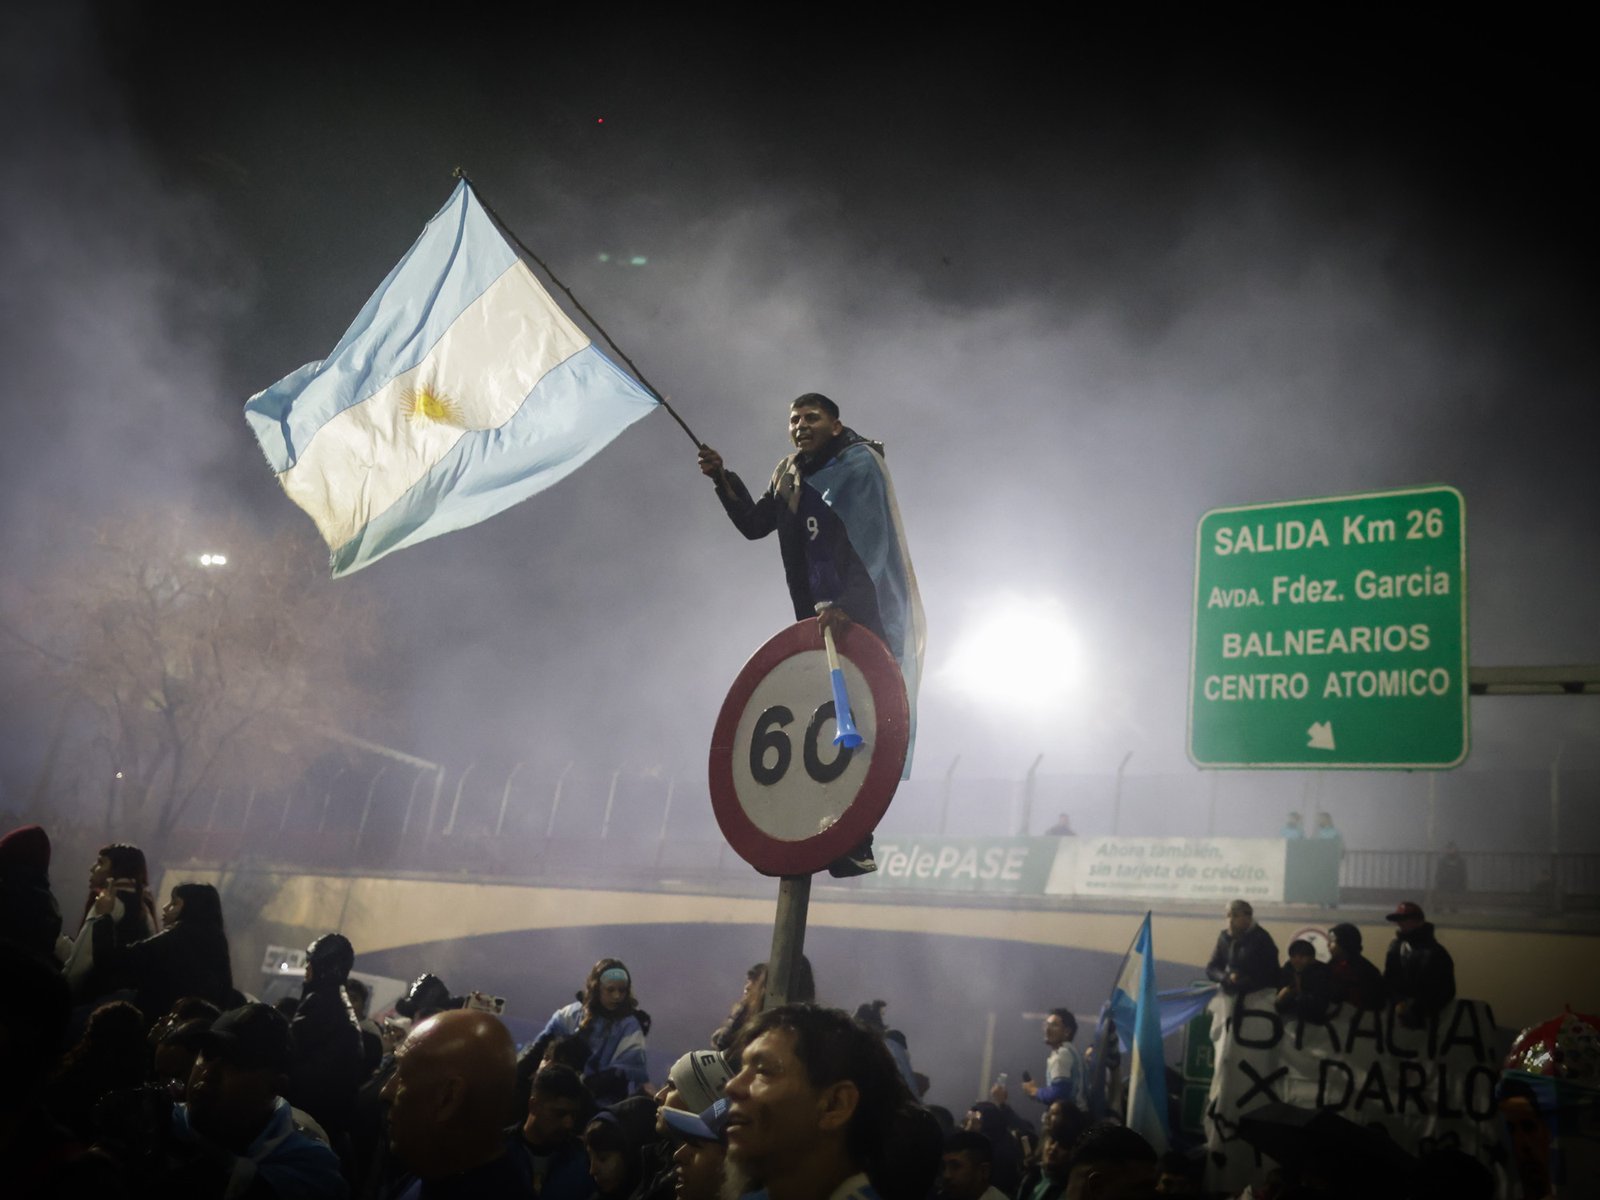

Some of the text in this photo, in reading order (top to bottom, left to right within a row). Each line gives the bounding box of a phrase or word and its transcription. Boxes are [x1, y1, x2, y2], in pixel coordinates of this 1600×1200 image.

[806, 516, 820, 540] 9
[1214, 508, 1444, 555] SALIDA Km 26
[1271, 574, 1344, 605] Fdez.
[1354, 565, 1450, 600] Garcia
[1222, 624, 1430, 658] BALNEARIOS
[1203, 667, 1450, 701] CENTRO ATOMICO
[749, 700, 859, 786] 60
[876, 844, 1030, 880] TelePASE
[1096, 843, 1145, 858] Ahora
[1116, 863, 1170, 880] tarjeta
[1175, 862, 1197, 878] de
[1233, 988, 1497, 1062] GRACIA
[1236, 1059, 1499, 1121] X DARLO
